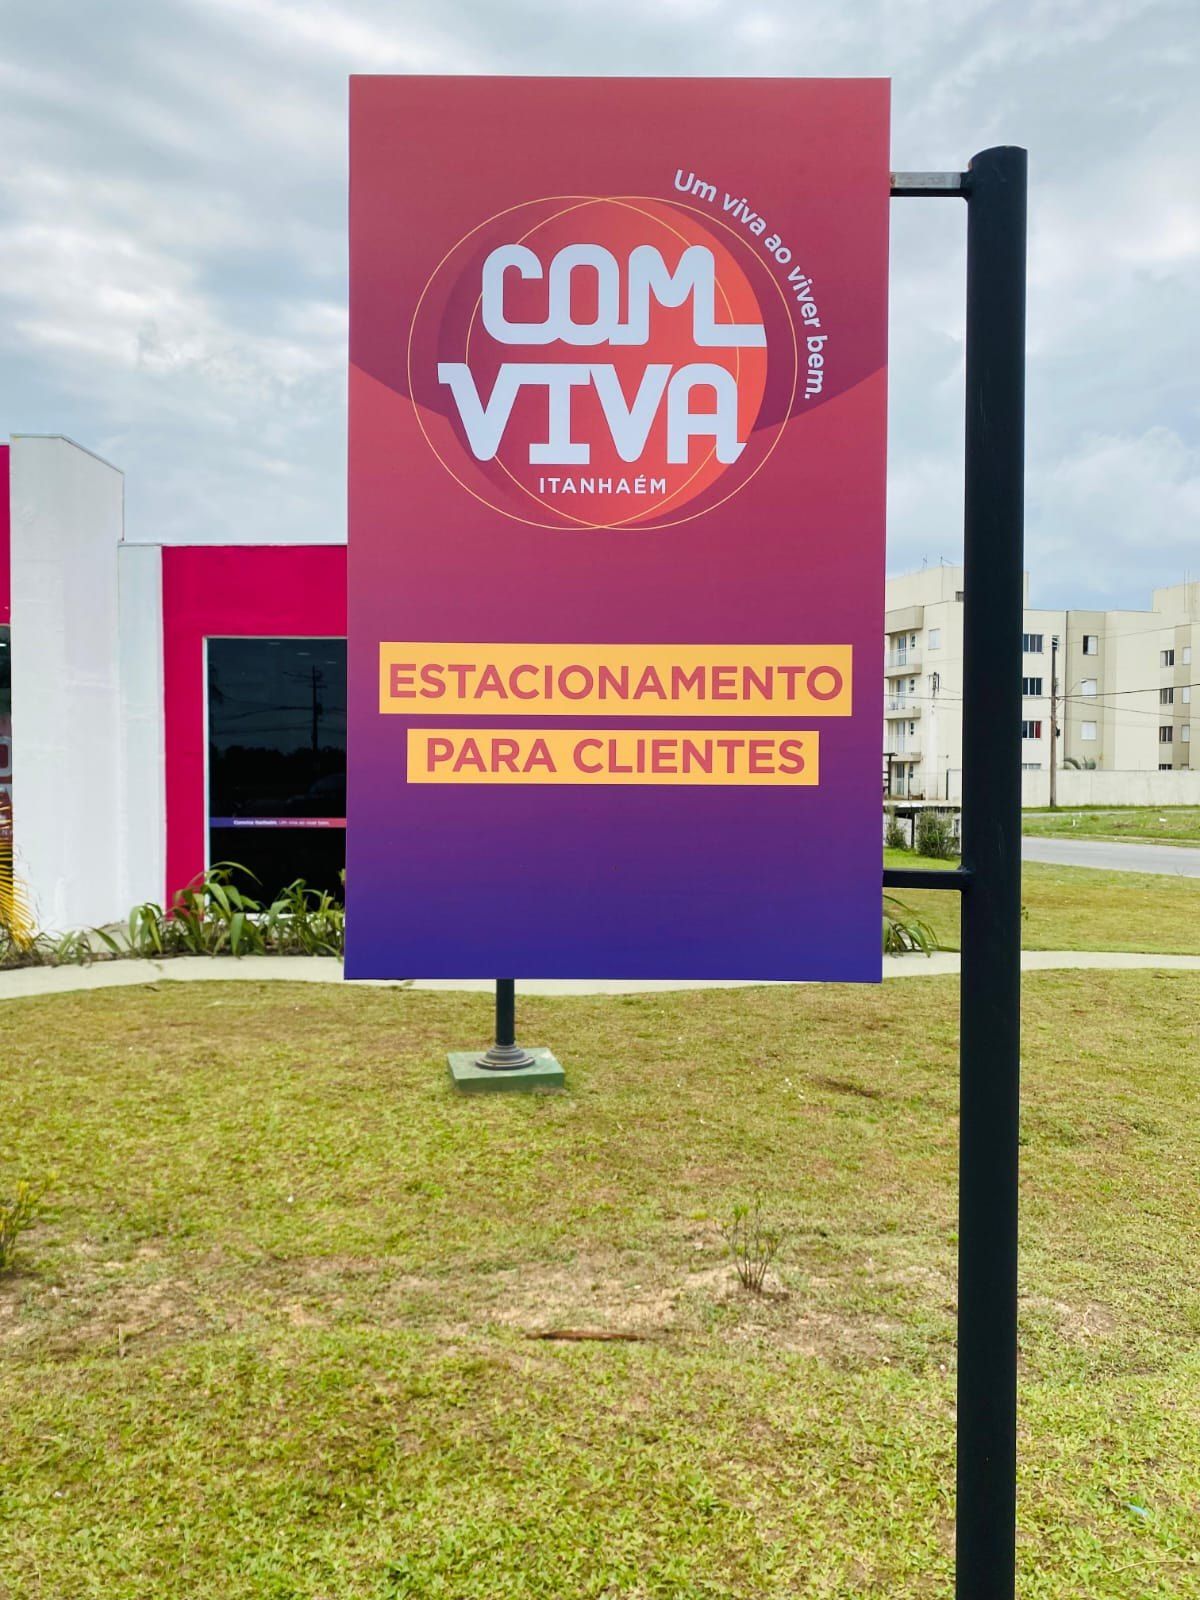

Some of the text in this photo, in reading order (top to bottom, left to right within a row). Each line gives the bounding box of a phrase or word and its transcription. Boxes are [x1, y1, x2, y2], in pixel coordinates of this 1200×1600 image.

[481, 243, 768, 347] COM
[674, 168, 828, 400] Um viva ao viver bem.
[437, 362, 747, 465] VIVA
[538, 475, 667, 495] ITANHAÉM
[390, 662, 843, 701] ESTACIONAMENTO
[427, 737, 805, 774] PARA CLIENTES
